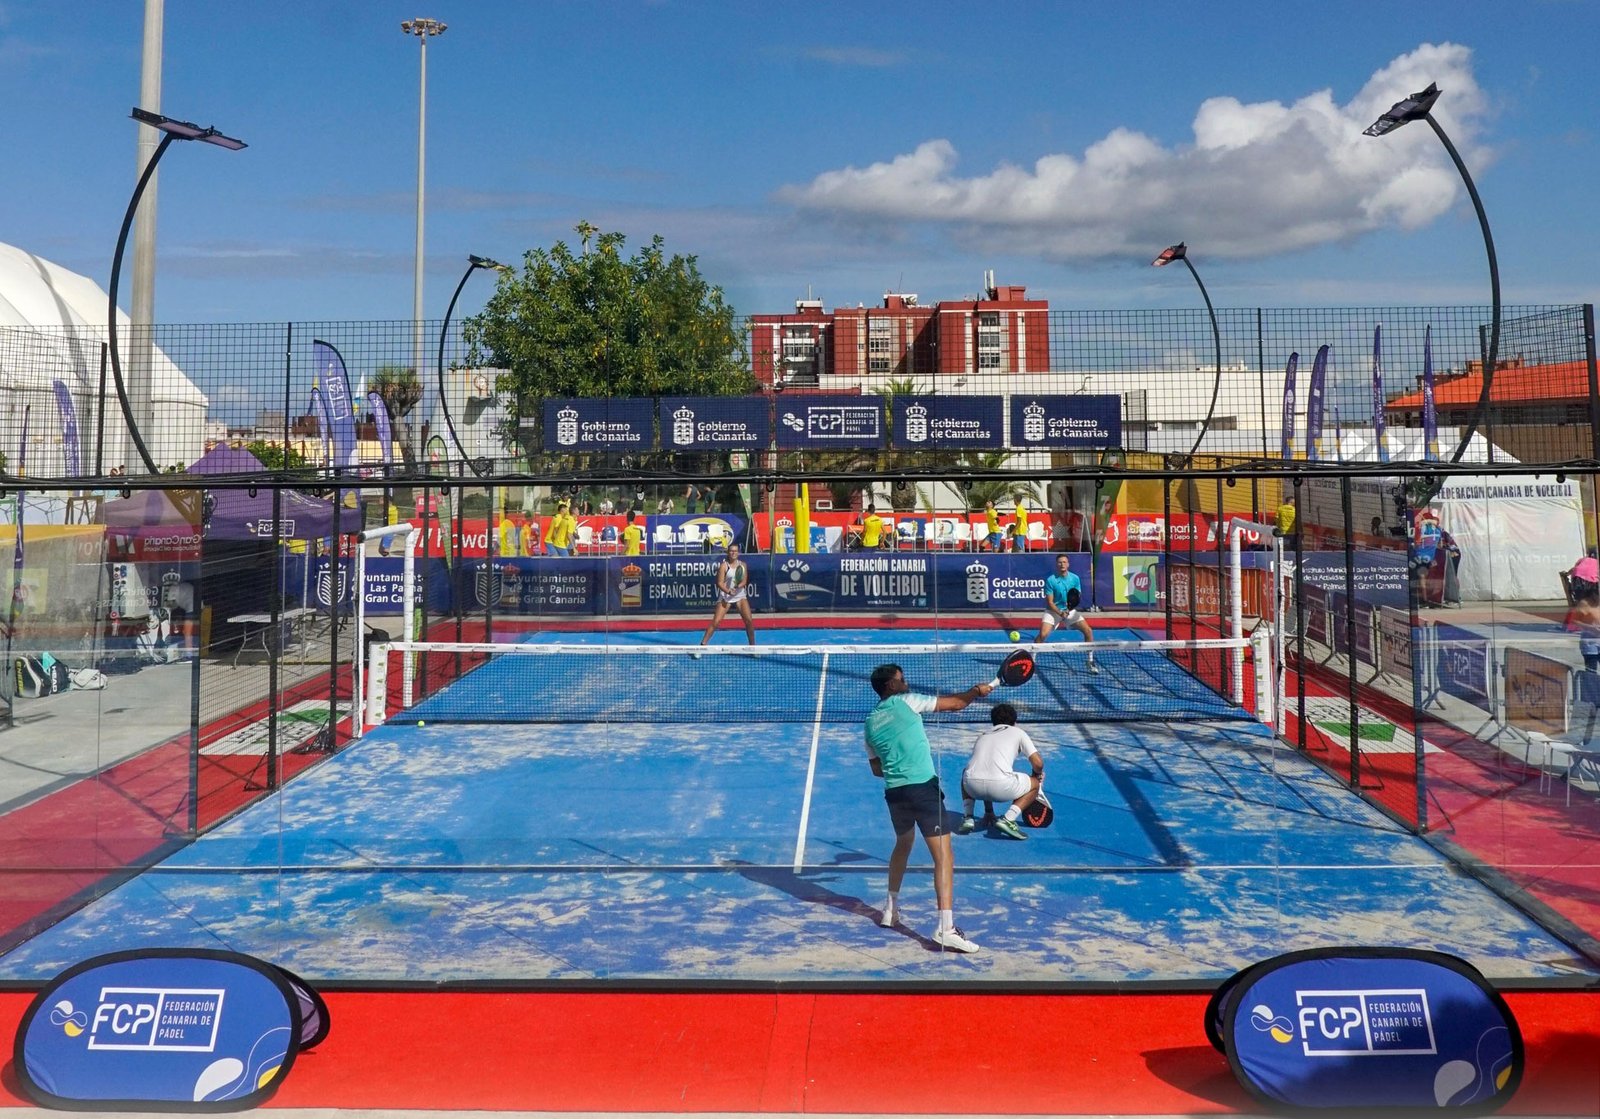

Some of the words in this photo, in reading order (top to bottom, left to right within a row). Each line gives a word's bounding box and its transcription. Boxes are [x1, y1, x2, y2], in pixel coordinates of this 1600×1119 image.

[581, 421, 630, 431] Gobierno
[697, 421, 746, 431] Gobierno
[808, 414, 842, 430] FCP
[931, 418, 980, 428] Gobierno
[1048, 418, 1098, 428] Gobierno
[581, 432, 594, 441] de
[596, 432, 641, 442] Canarias
[697, 432, 710, 441] de
[711, 432, 758, 442] Canarias
[931, 429, 943, 438] de
[944, 429, 991, 439] Canarias
[1048, 428, 1061, 438] de
[1062, 428, 1109, 438] Canarias
[1524, 485, 1534, 497] DE
[649, 563, 673, 577] REAL
[675, 562, 720, 577] FEDERAC
[781, 559, 810, 573] FCVB
[840, 557, 889, 572] FEDERACIÓN
[891, 559, 927, 572] CANARIA
[370, 583, 387, 593] Las
[841, 574, 858, 596] DE
[863, 574, 927, 596] VOLEIBOL
[992, 577, 1045, 588] Gobierno
[549, 585, 587, 594] Palmas
[649, 582, 698, 599] ESPAÑOLA
[700, 586, 711, 598] DE
[992, 588, 1007, 599] de
[1008, 588, 1046, 599] Canari
[365, 594, 389, 603] Gran
[524, 595, 546, 604] Gran
[549, 595, 586, 604] Canaria
[164, 1001, 215, 1012] FEDERACIÓN
[1369, 1001, 1422, 1014] FEDERACIÓN
[91, 1003, 155, 1033] FCP
[161, 1014, 199, 1026] CANARIA
[200, 1015, 211, 1026] DE
[1299, 1007, 1362, 1039] FCP
[1371, 1016, 1410, 1028] CANARIA
[1411, 1016, 1423, 1028] DE
[158, 1026, 185, 1039] PÁDEL
[1374, 1029, 1401, 1042] PÁDEL
